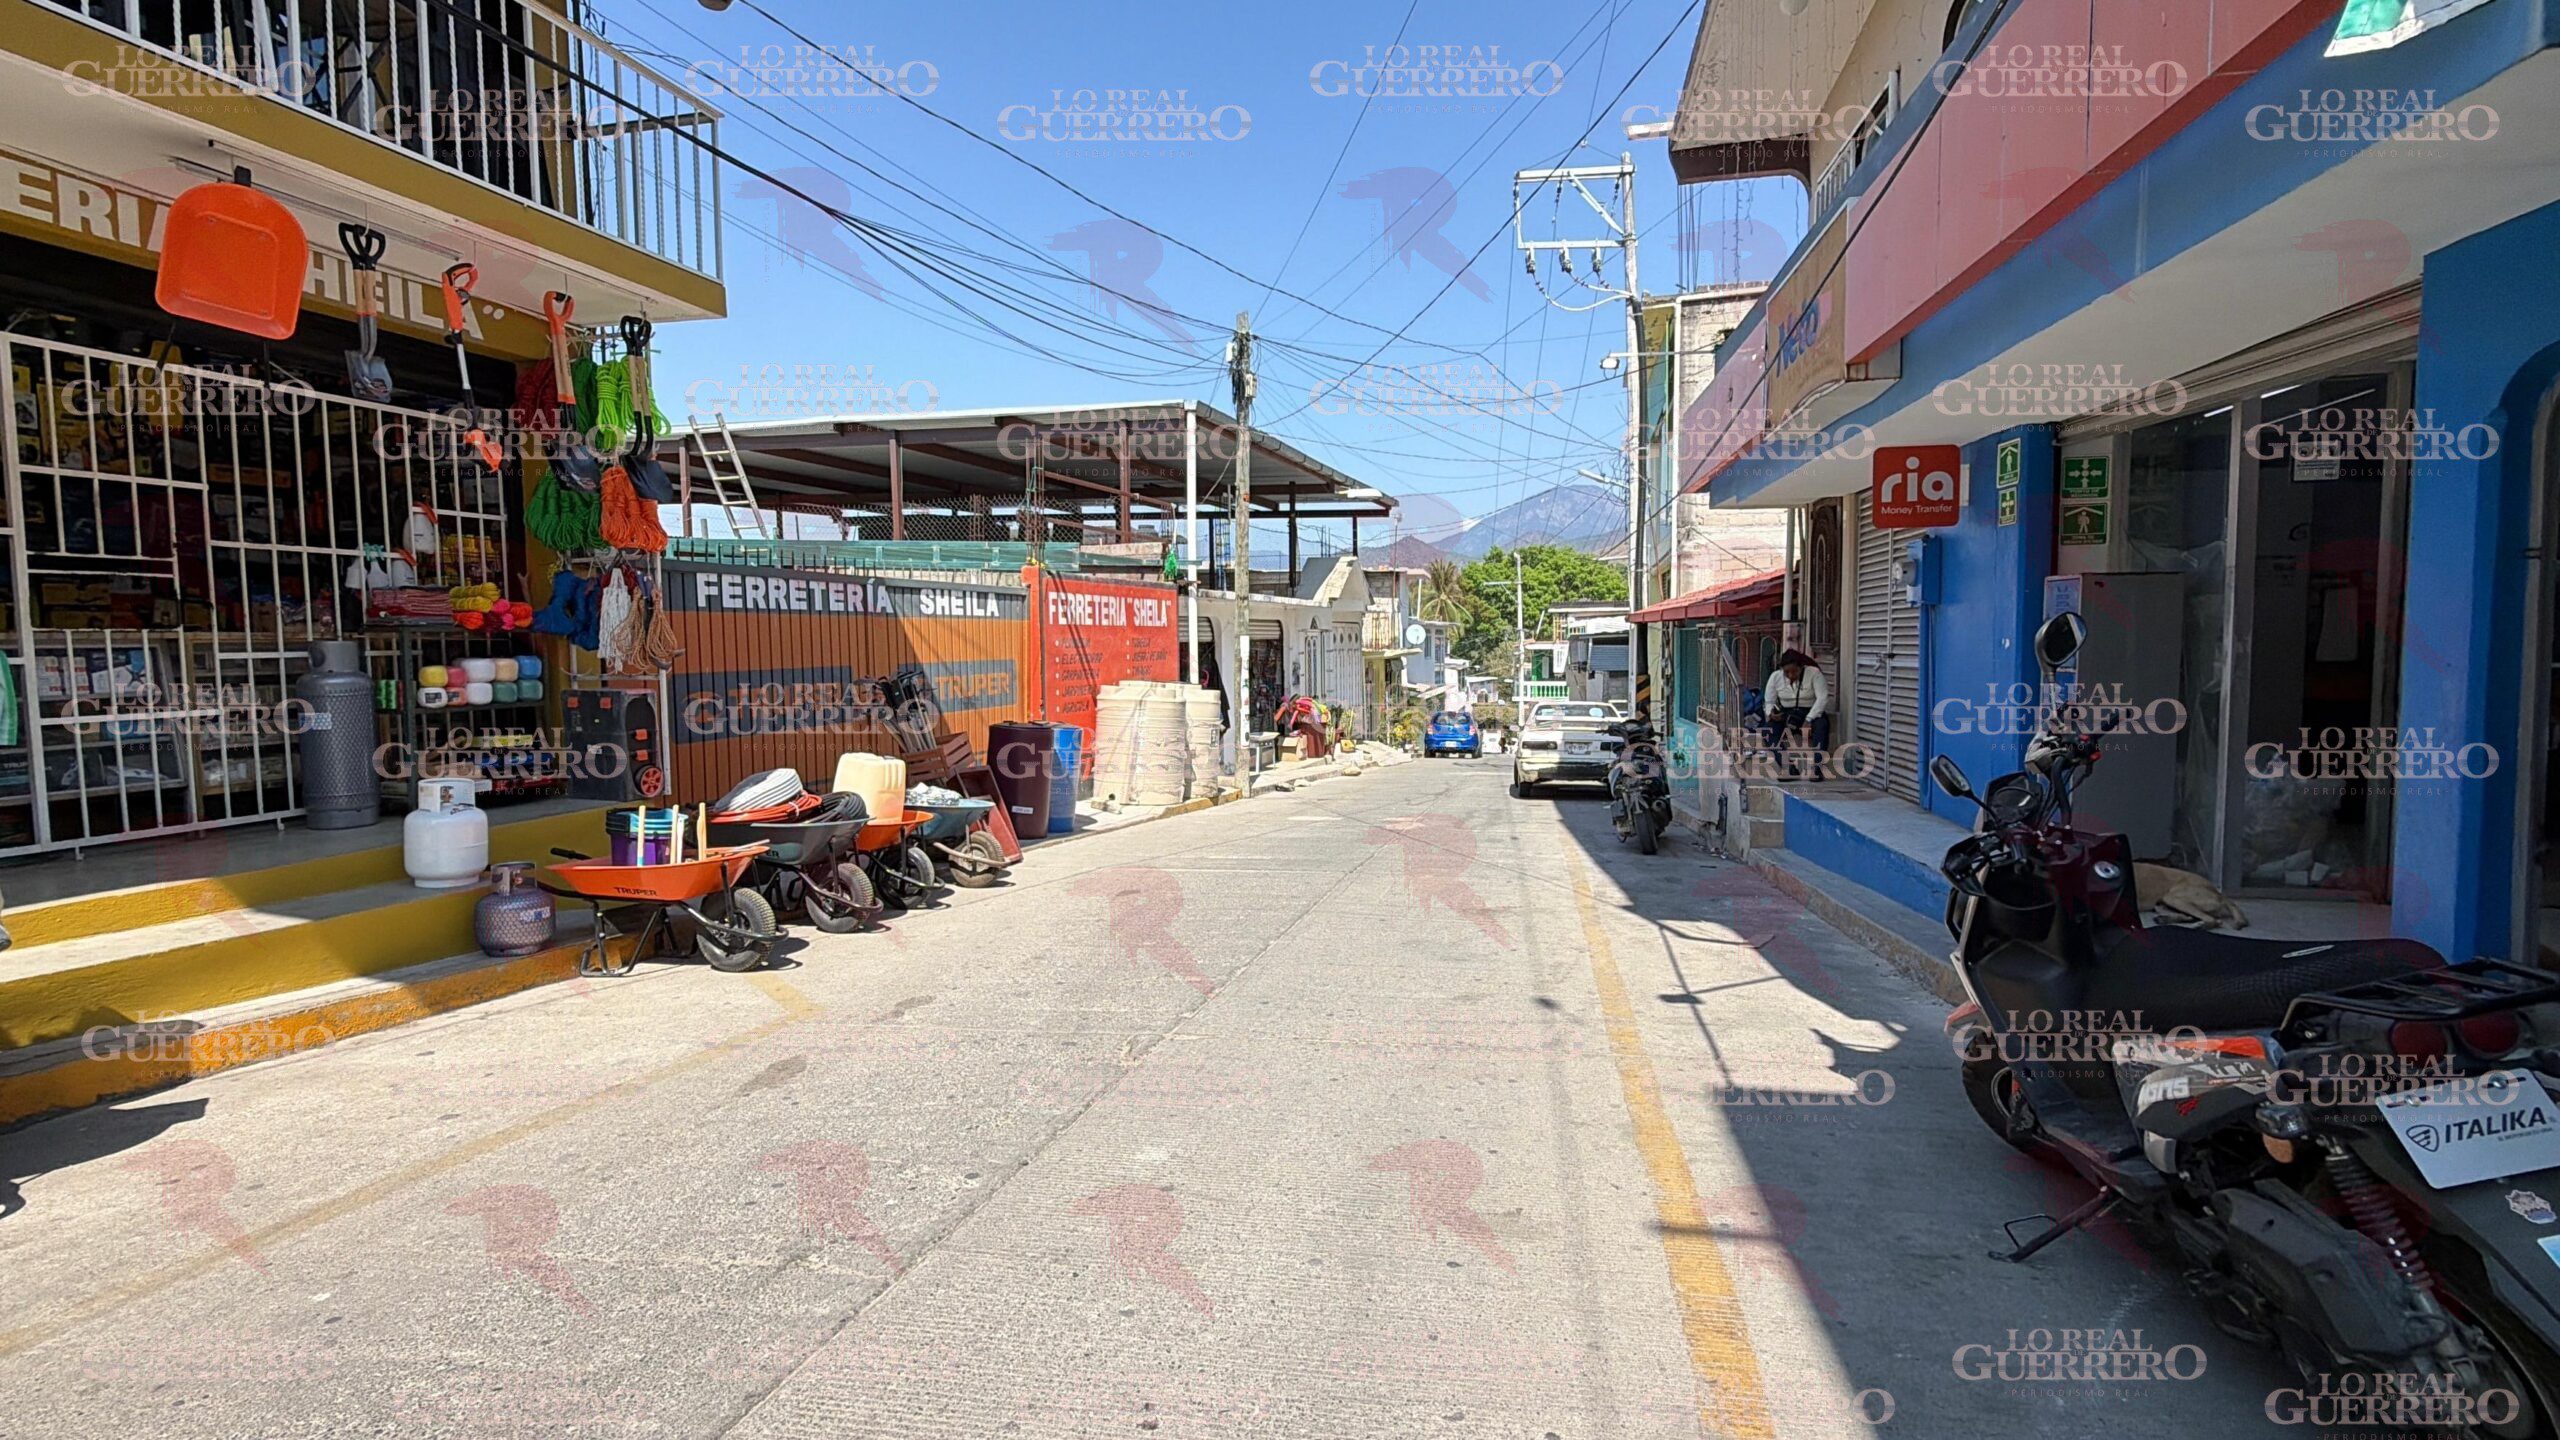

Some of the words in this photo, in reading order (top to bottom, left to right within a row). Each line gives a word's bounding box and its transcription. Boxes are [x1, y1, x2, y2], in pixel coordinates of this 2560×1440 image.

[1881, 456, 1954, 503] ria
[1881, 506, 1913, 515] Money
[1915, 504, 1953, 513] Transfer
[696, 571, 894, 614] FERRETERÍA
[919, 588, 1000, 617] SHEILA
[1048, 591, 1127, 627] FERRETERIA
[934, 672, 1010, 701] TRUPER
[613, 886, 658, 896] TRUPER
[2445, 1106, 2547, 1144] ITALIKA
